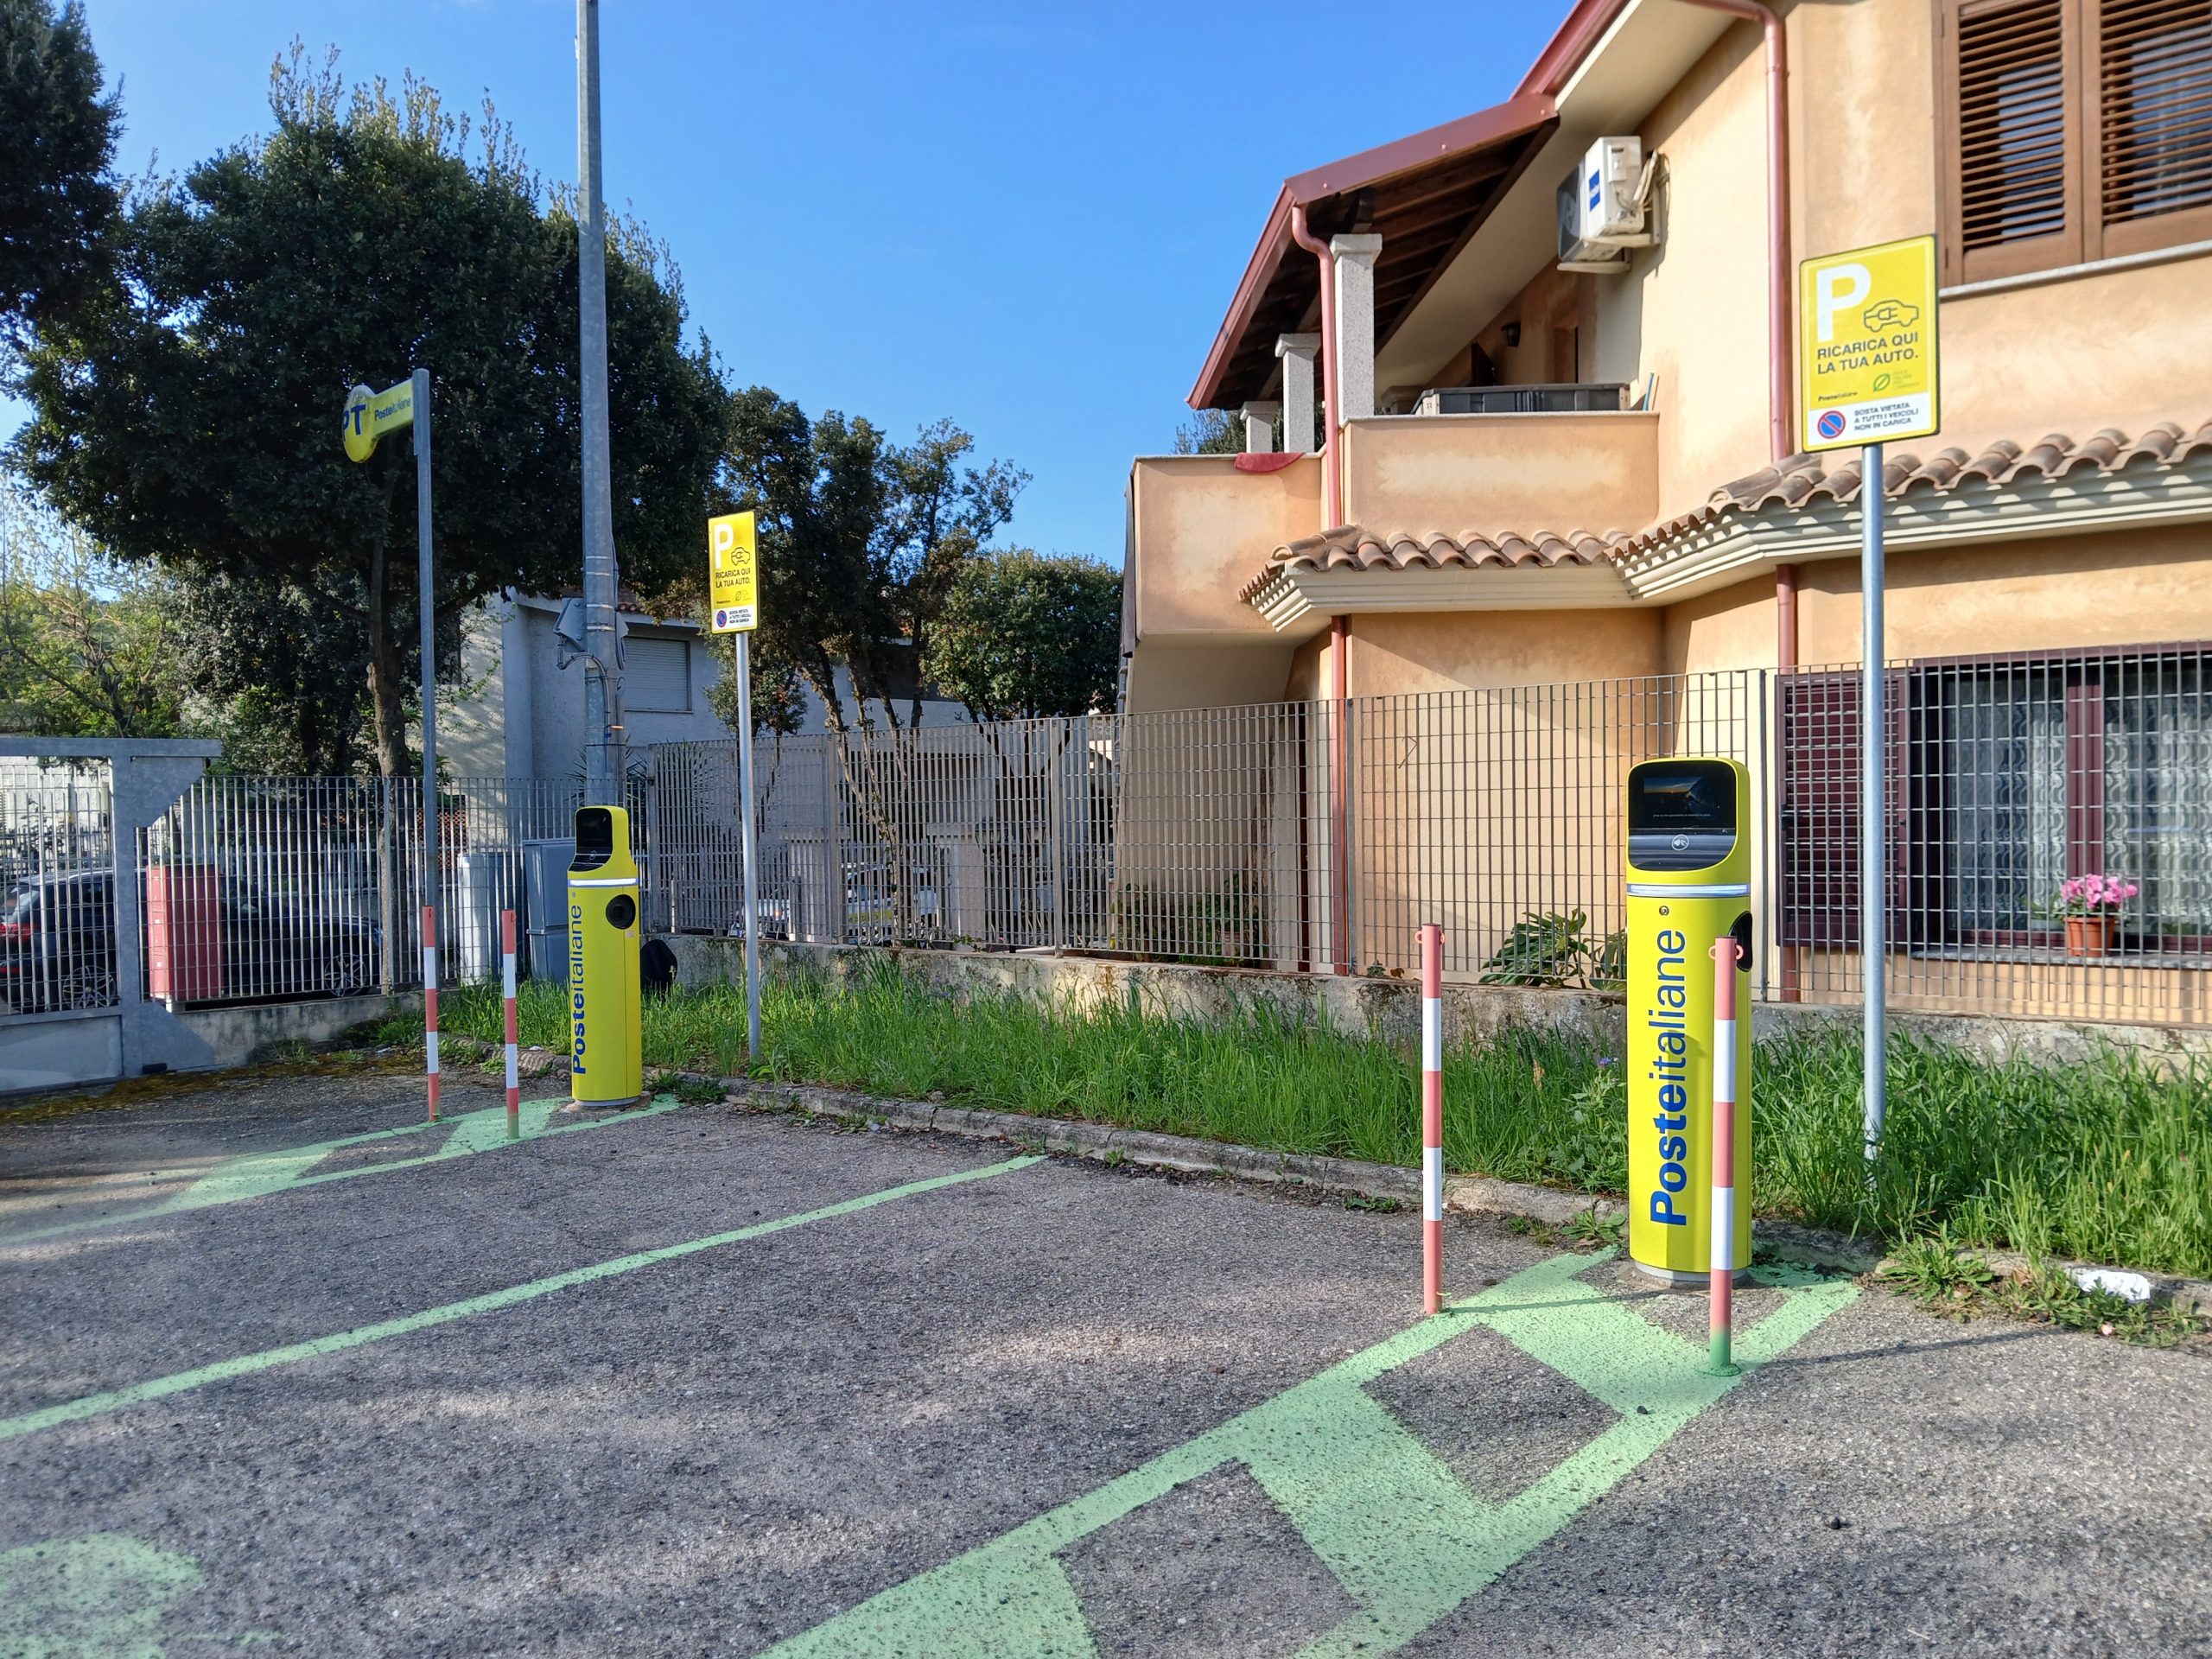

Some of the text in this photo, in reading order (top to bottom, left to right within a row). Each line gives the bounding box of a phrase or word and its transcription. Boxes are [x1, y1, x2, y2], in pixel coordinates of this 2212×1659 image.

[1816, 263, 1872, 343] P
[1817, 332, 1918, 359] RICARICA QUI
[1817, 348, 1918, 375] LA TUA AUTO.
[1854, 403, 1910, 416] SOSTA VIETATA
[1883, 417, 1911, 427] CARICA
[1889, 408, 1919, 417] VEICOLI
[714, 523, 734, 569] P
[715, 569, 741, 579] RICARICA
[735, 576, 751, 585] AUTO.
[570, 905, 586, 1075] Posteitaliane
[1649, 929, 1688, 1226] Posteitaliane
